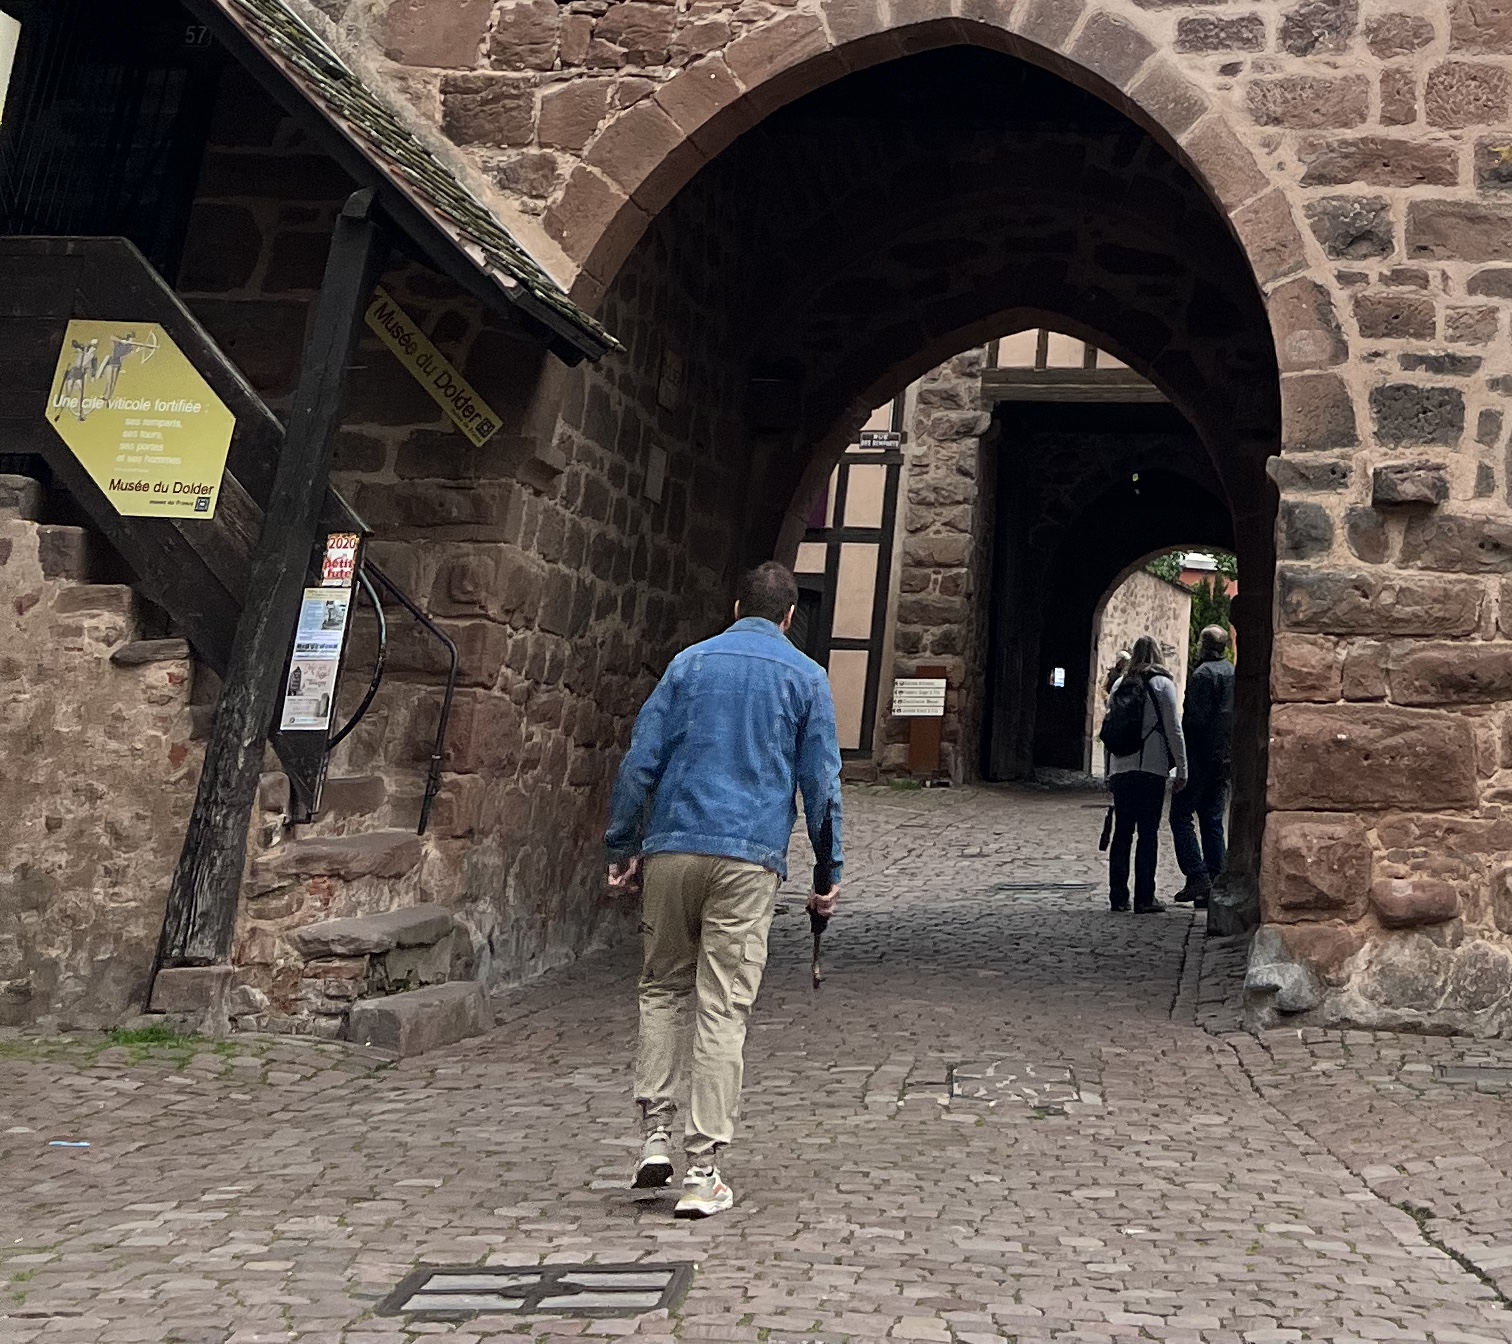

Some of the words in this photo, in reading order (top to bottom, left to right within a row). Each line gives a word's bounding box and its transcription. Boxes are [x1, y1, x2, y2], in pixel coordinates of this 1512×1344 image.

[185, 25, 208, 44] 57
[374, 301, 418, 356] Musée
[416, 353, 438, 378] du
[433, 370, 482, 423] Dolder
[53, 395, 78, 408] Une
[107, 397, 151, 411] viticole
[109, 479, 149, 492] Musée
[153, 481, 170, 493] du
[173, 482, 214, 495] Dolder
[329, 537, 356, 549] 2020
